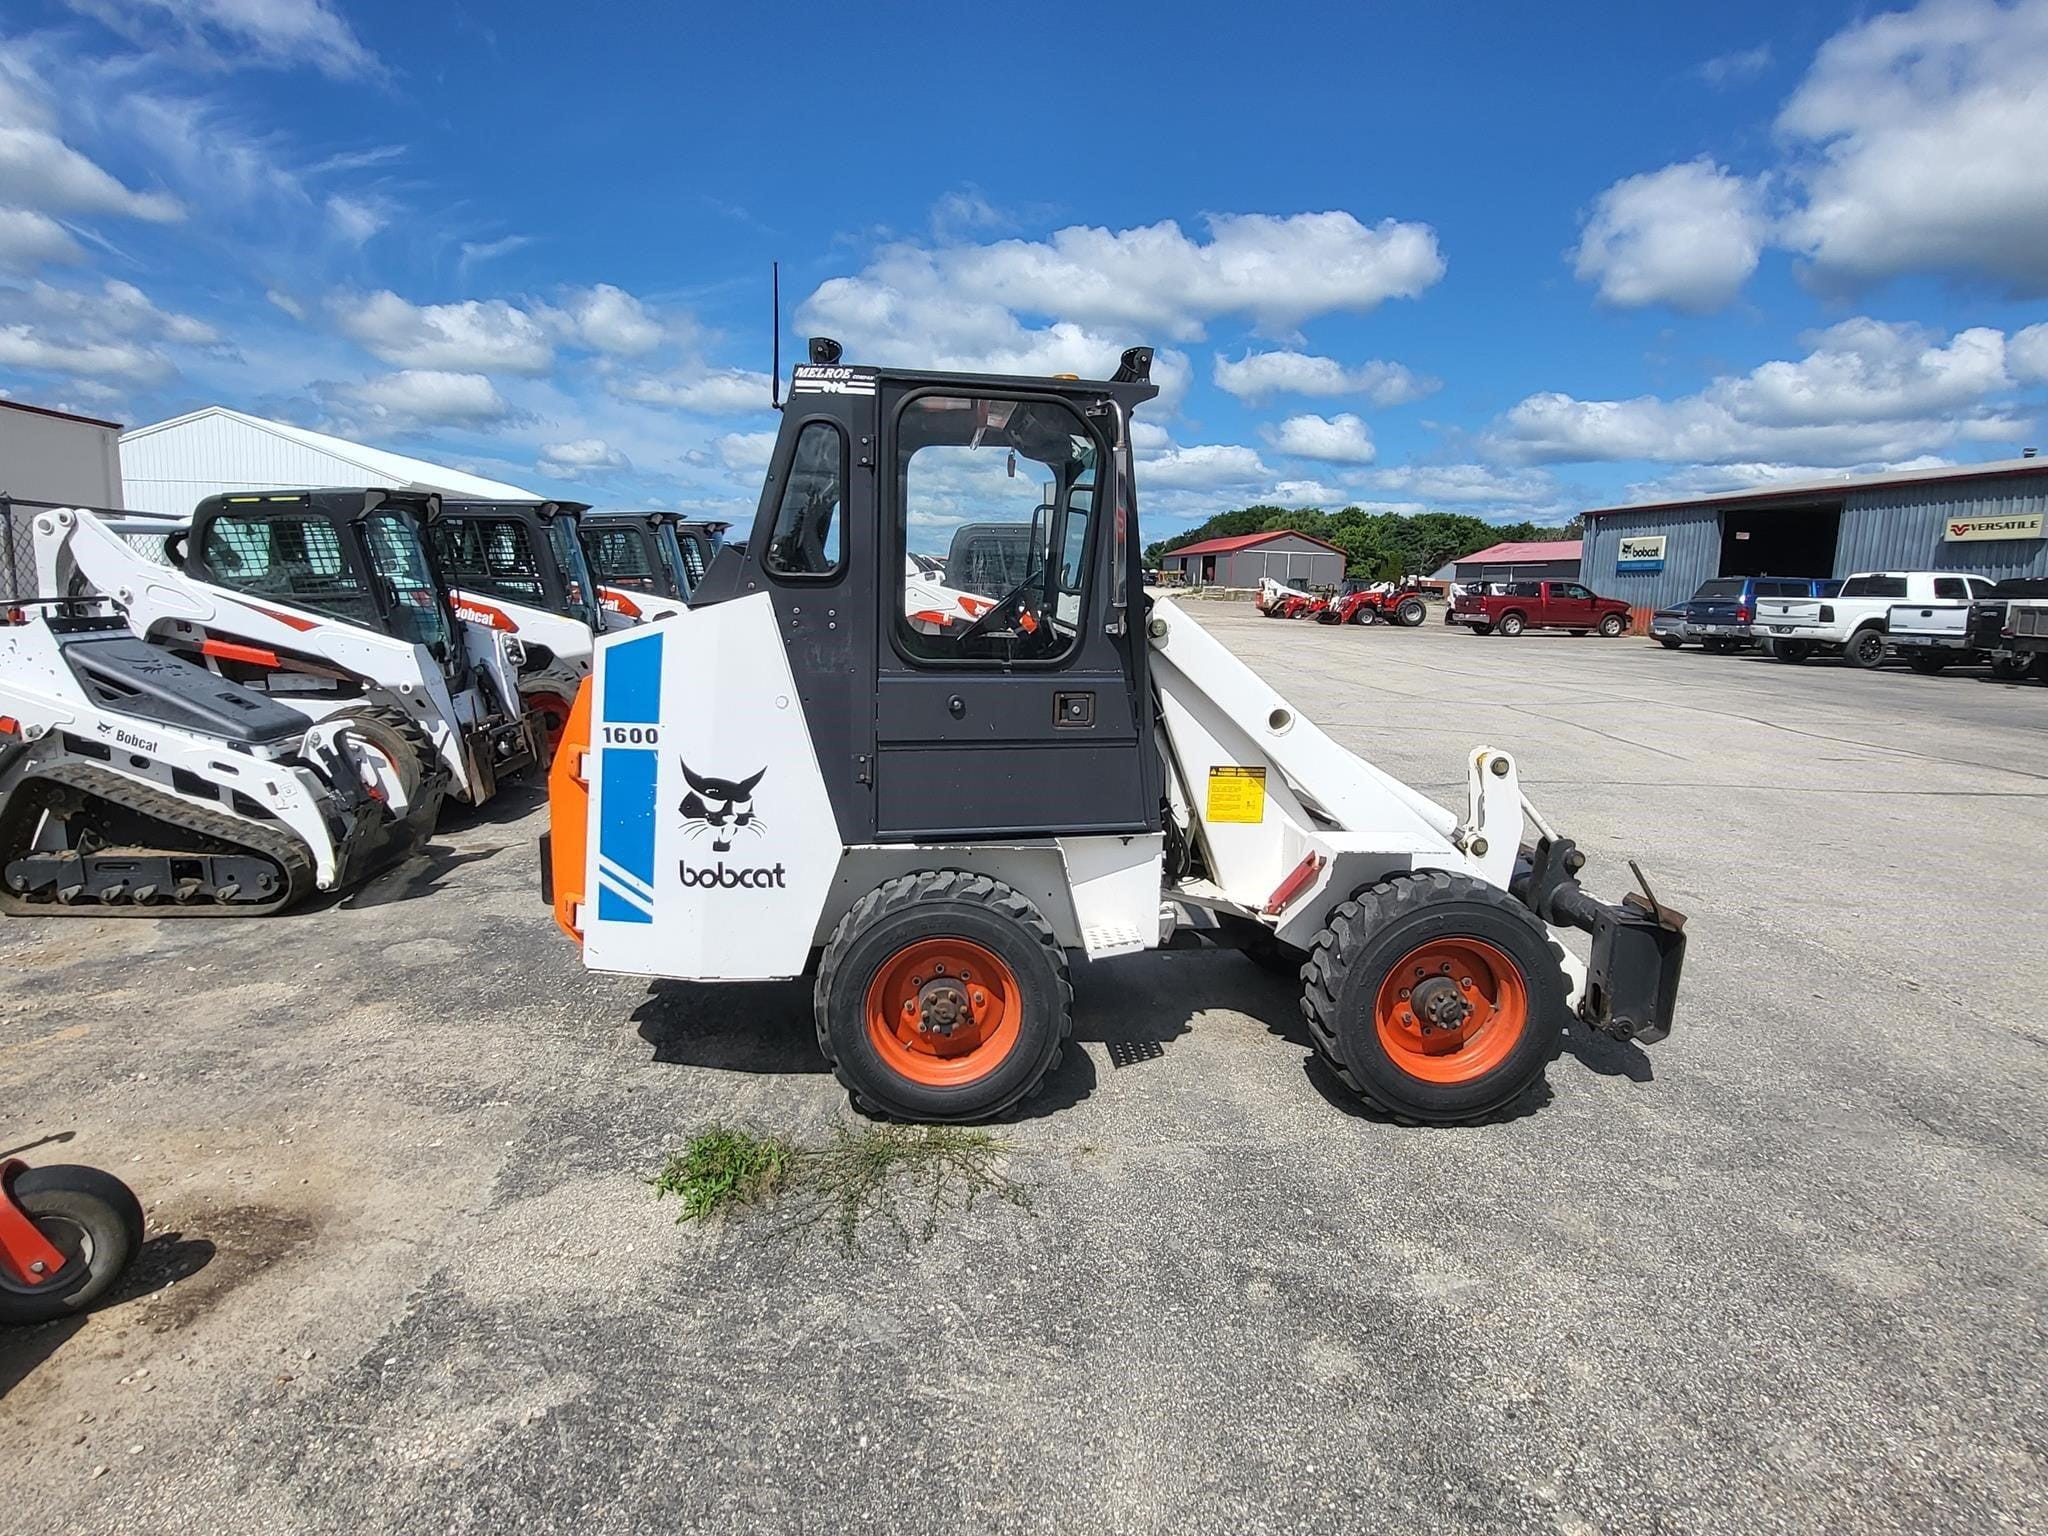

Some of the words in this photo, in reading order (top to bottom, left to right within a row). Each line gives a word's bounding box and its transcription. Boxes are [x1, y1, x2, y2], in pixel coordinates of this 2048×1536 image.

[795, 367, 854, 379] MELROE
[1970, 520, 2039, 531] VERSATILE
[1632, 546, 1659, 558] bobcat
[116, 729, 158, 753] Bobcat
[602, 727, 659, 744] 1600
[679, 859, 786, 889] bobcat
